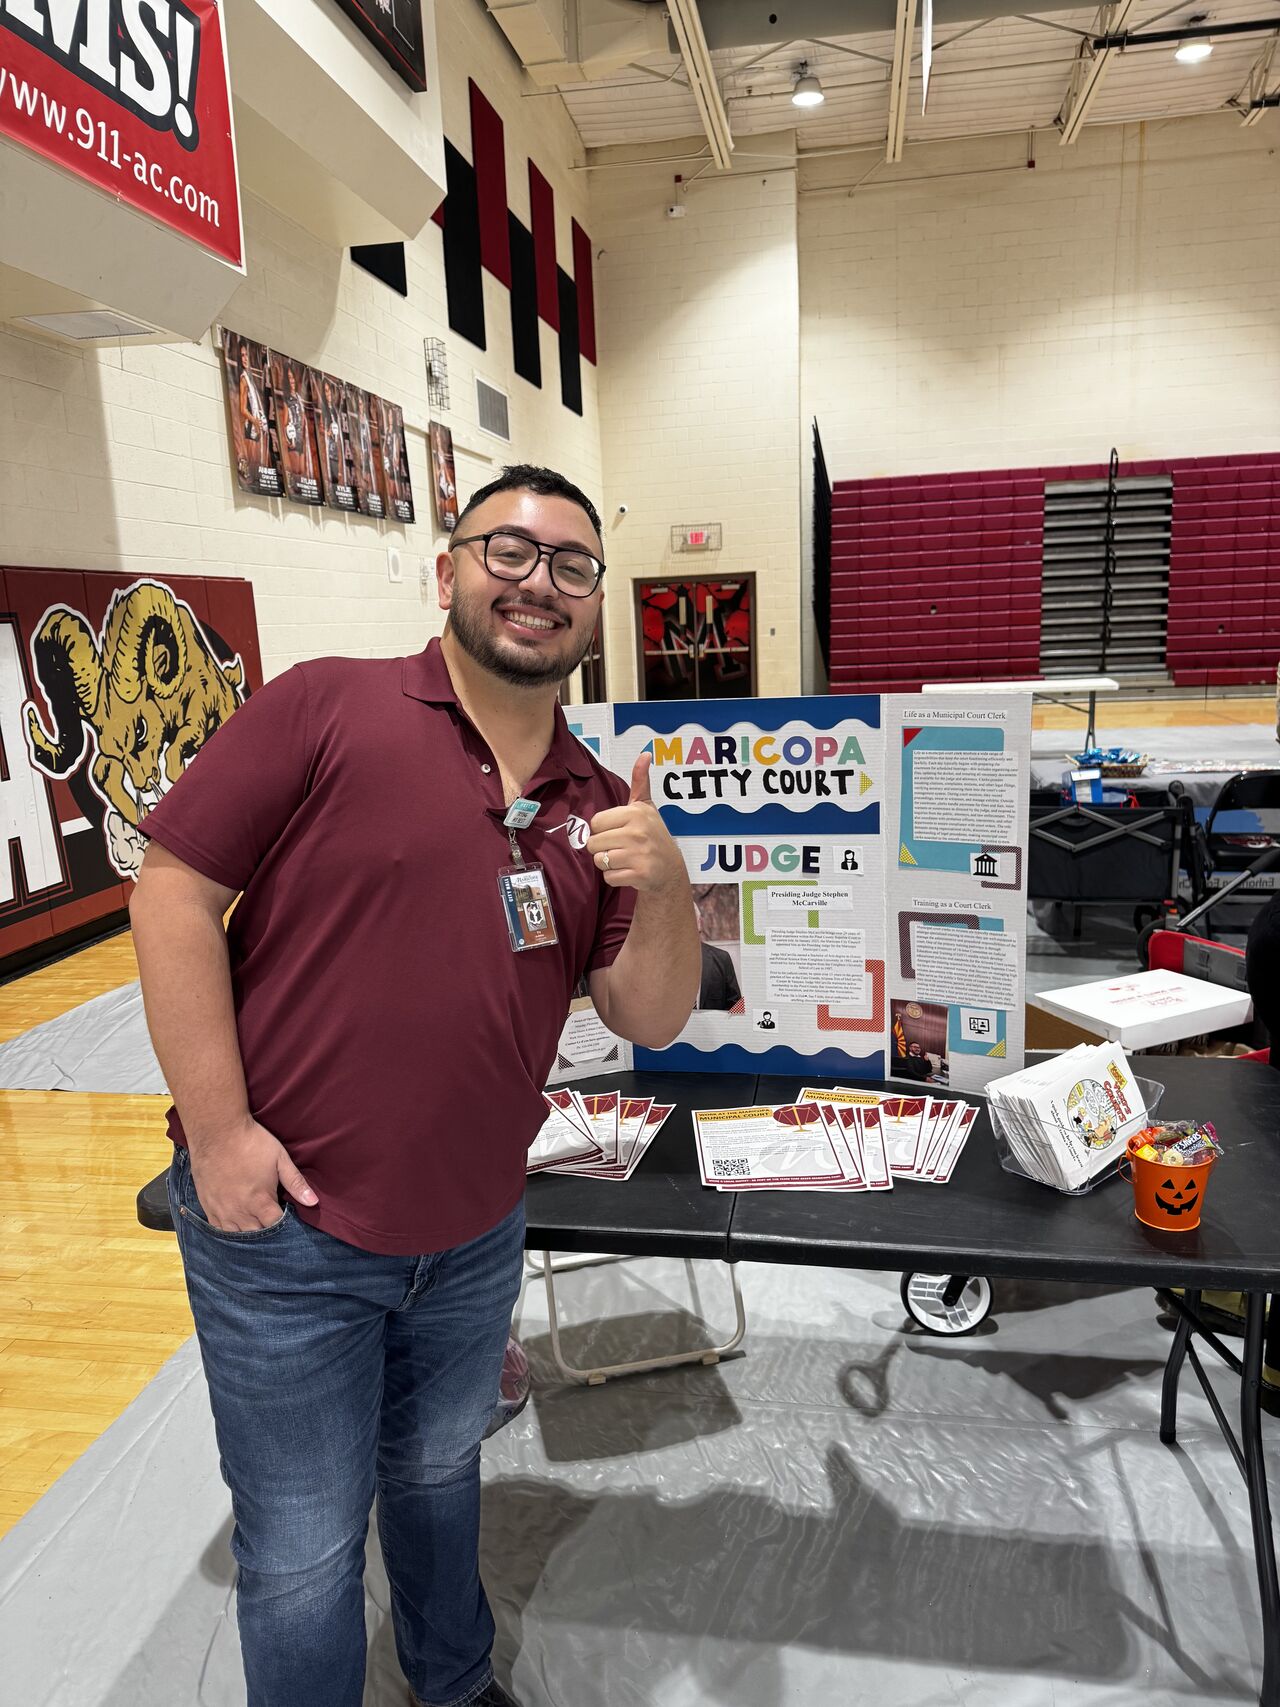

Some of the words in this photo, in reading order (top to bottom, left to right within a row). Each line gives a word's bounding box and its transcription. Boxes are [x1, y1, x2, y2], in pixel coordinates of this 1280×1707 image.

[0, 0, 194, 138] MS!
[904, 710, 917, 718] Life
[932, 711, 965, 720] Municipal
[987, 712, 1006, 720] Clerk
[654, 736, 866, 766] MARICOPA
[663, 768, 752, 800] CITY
[762, 768, 855, 797] COURT
[700, 844, 821, 873] JUDGE
[913, 899, 939, 908] Training
[954, 900, 972, 909] Court
[973, 902, 992, 910] Clerk
